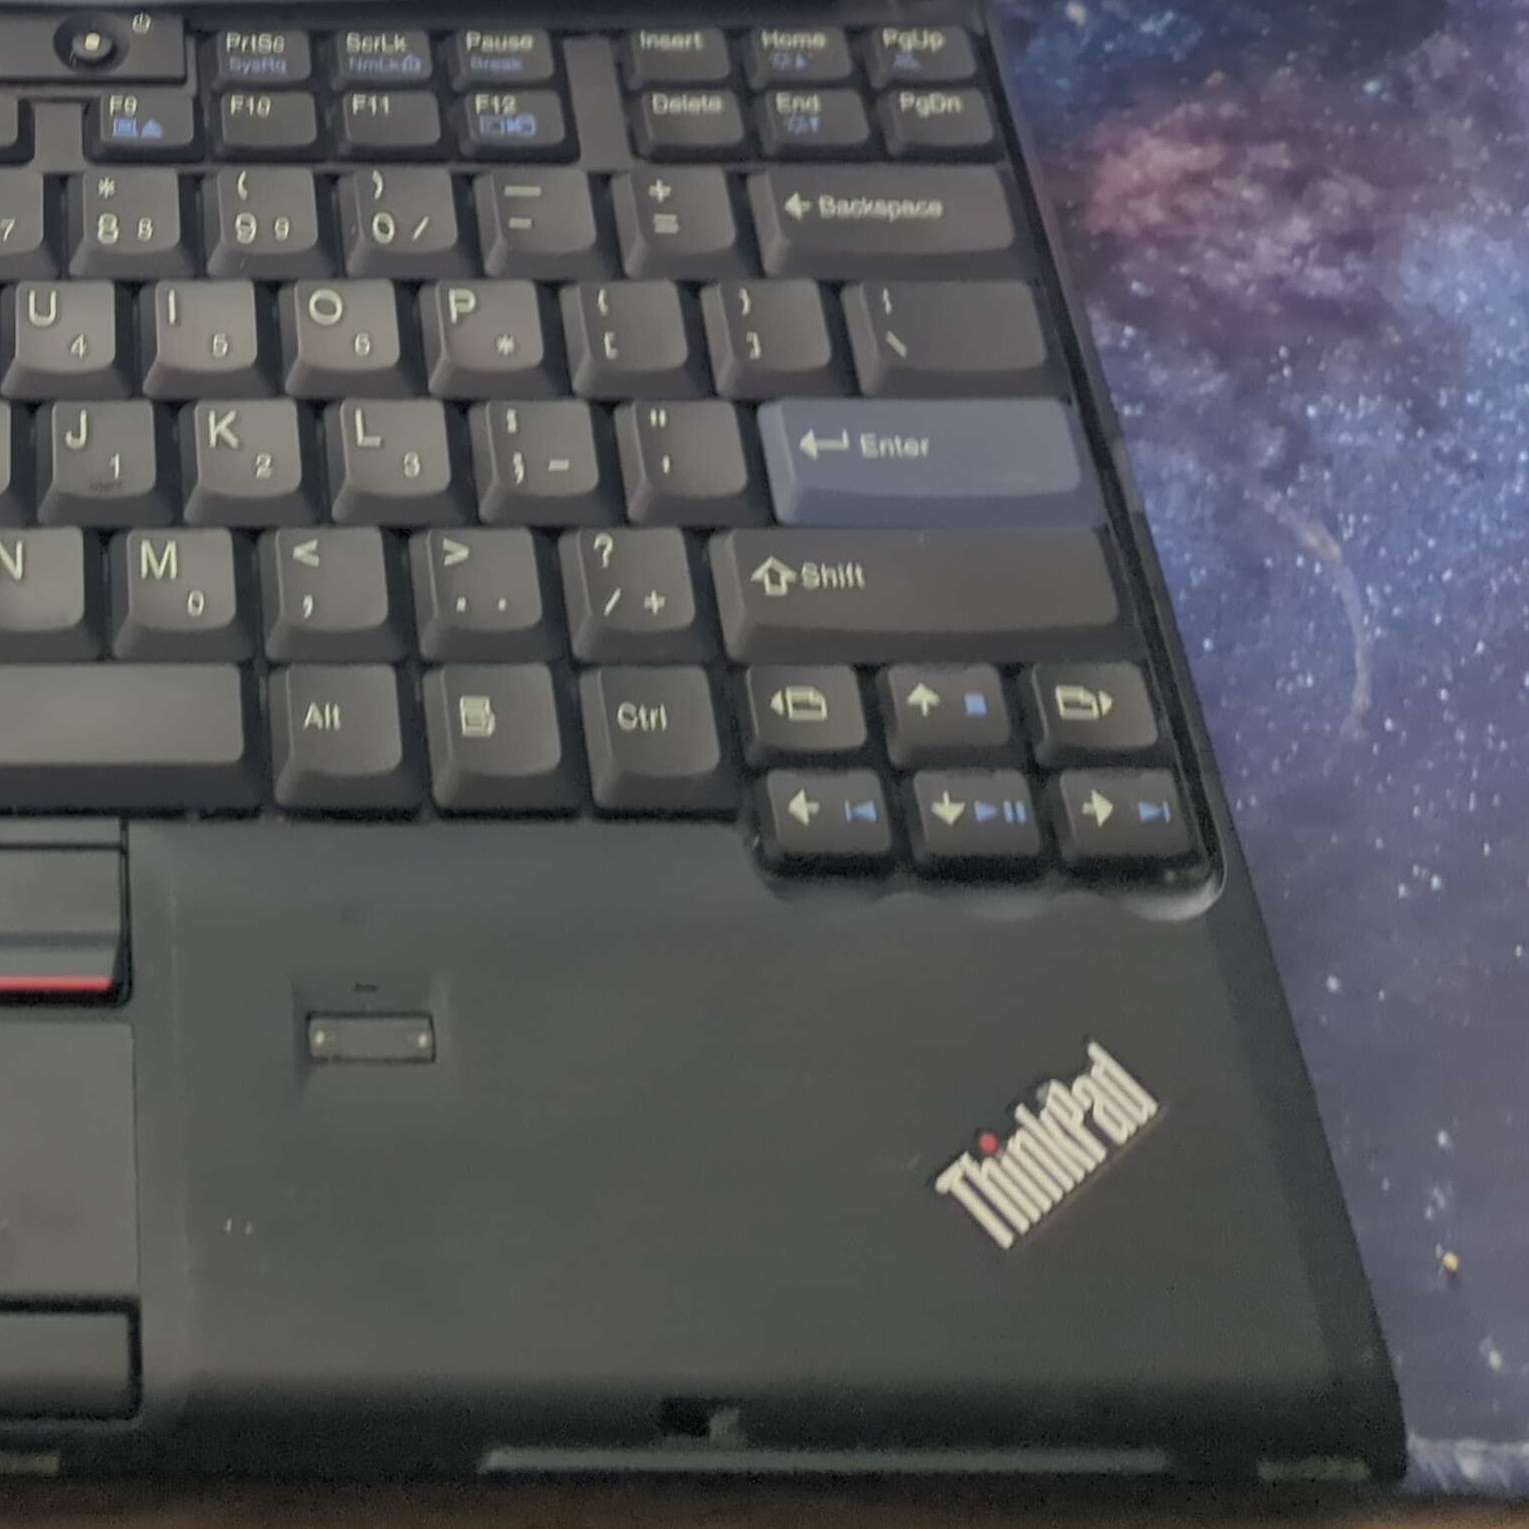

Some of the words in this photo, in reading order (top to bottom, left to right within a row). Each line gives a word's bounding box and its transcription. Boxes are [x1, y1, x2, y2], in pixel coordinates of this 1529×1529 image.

[226, 31, 285, 53] PrtSc
[346, 31, 408, 54] ScrLk
[465, 30, 534, 53] Pause
[639, 29, 704, 51] Insert
[762, 29, 827, 50] Home
[882, 27, 945, 52] PgUp
[471, 55, 522, 72] Break
[109, 94, 138, 117] F9
[229, 94, 272, 117] F10
[351, 93, 391, 116] F11
[474, 93, 517, 115] F12
[651, 92, 724, 115] Delete
[775, 91, 820, 115] End
[899, 91, 961, 118] PgDn
[648, 177, 672, 203] +
[818, 194, 944, 222] Backspace
[0, 217, 16, 243] 7
[97, 212, 120, 246] 8
[137, 217, 154, 242] 8
[234, 212, 258, 245] 9
[274, 216, 290, 241] 9
[372, 211, 396, 245] 0
[28, 289, 58, 328] U
[448, 287, 477, 324] P
[70, 332, 87, 359] 4
[211, 332, 229, 359] 5
[354, 331, 372, 358] 6
[64, 408, 89, 451] J
[207, 409, 241, 451] K
[354, 406, 383, 449] L
[858, 431, 931, 461] Enter
[107, 452, 121, 481] 1
[254, 451, 274, 479] 2
[402, 450, 422, 479] 3
[139, 538, 179, 582] M
[291, 537, 321, 569] <
[441, 536, 471, 567] >
[593, 531, 615, 570] ?
[801, 560, 867, 591] Shift
[186, 588, 206, 619] 0
[603, 586, 623, 617] /
[642, 588, 667, 616] +
[303, 700, 342, 732] Alt
[615, 700, 669, 733] Ctrl
[935, 1040, 1159, 1250] ThinkPad
